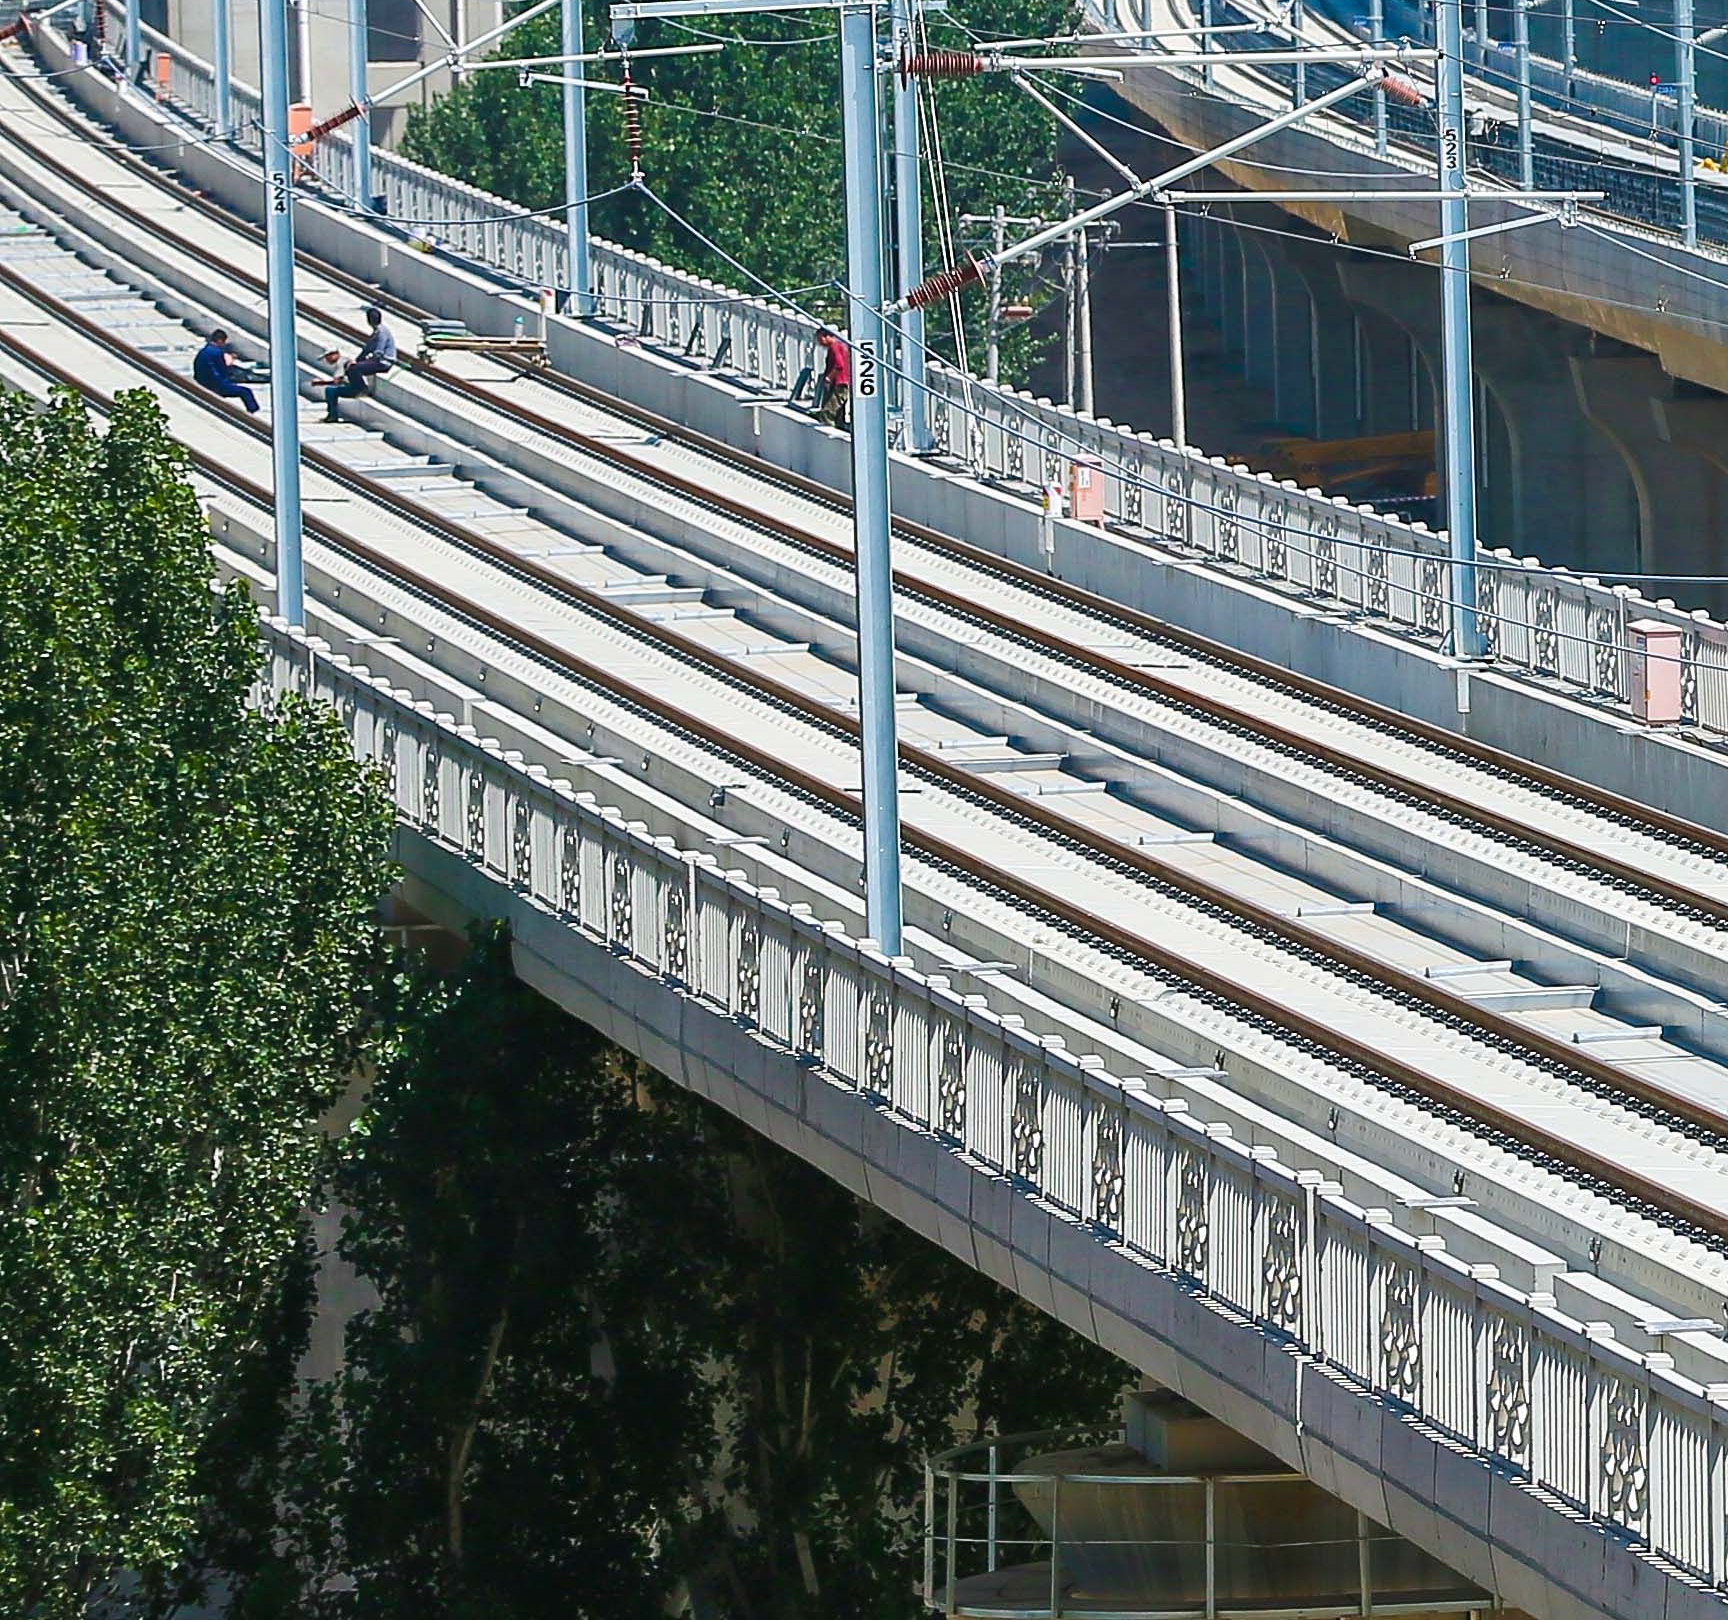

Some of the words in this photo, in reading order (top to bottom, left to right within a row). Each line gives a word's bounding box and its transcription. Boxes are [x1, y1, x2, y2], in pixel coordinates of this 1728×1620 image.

[1445, 129, 1457, 169] 523
[273, 174, 286, 213] 524
[859, 342, 875, 396] 526
